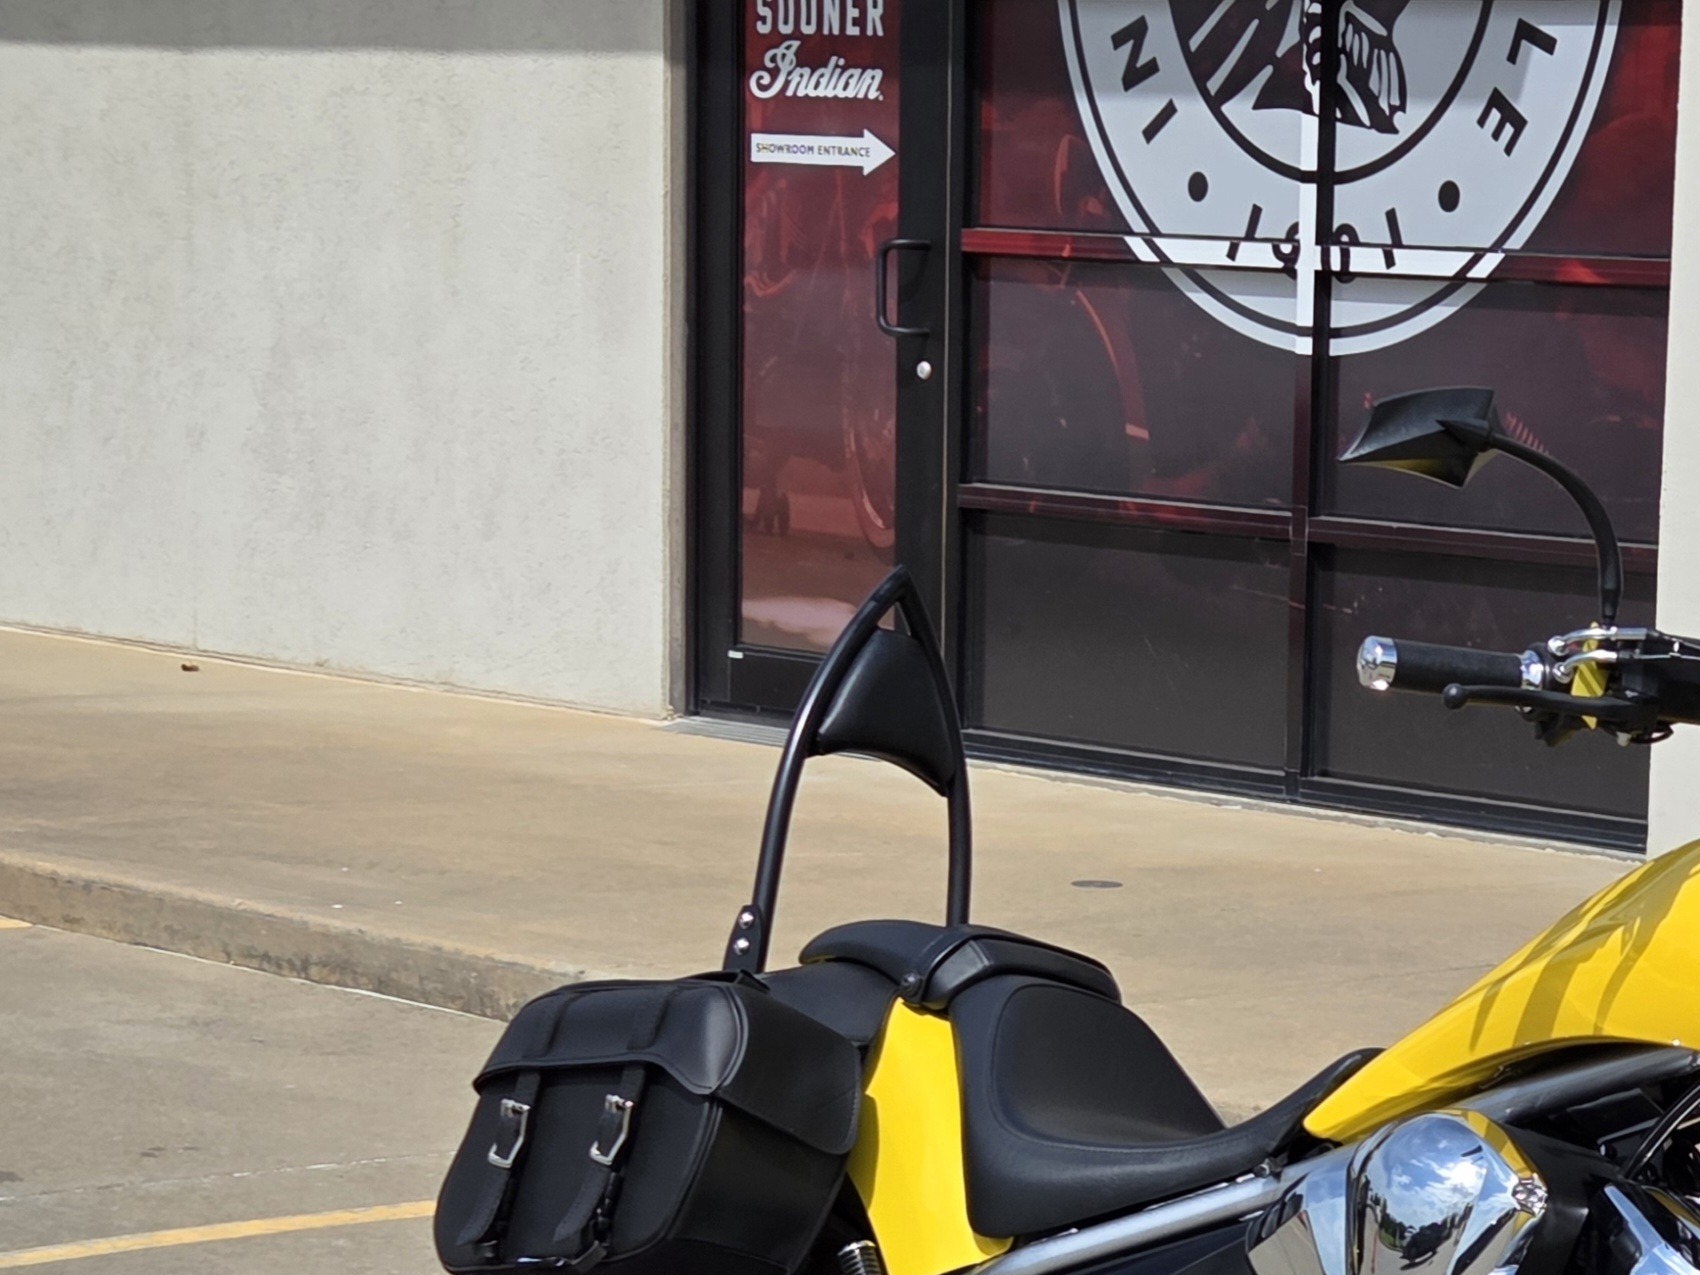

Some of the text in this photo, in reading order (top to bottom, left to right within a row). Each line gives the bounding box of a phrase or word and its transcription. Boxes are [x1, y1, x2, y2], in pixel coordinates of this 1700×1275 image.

[756, 0, 884, 37] SOONER
[749, 40, 884, 99] Indian
[756, 142, 871, 158] SHOWROOM ENTRANCE
